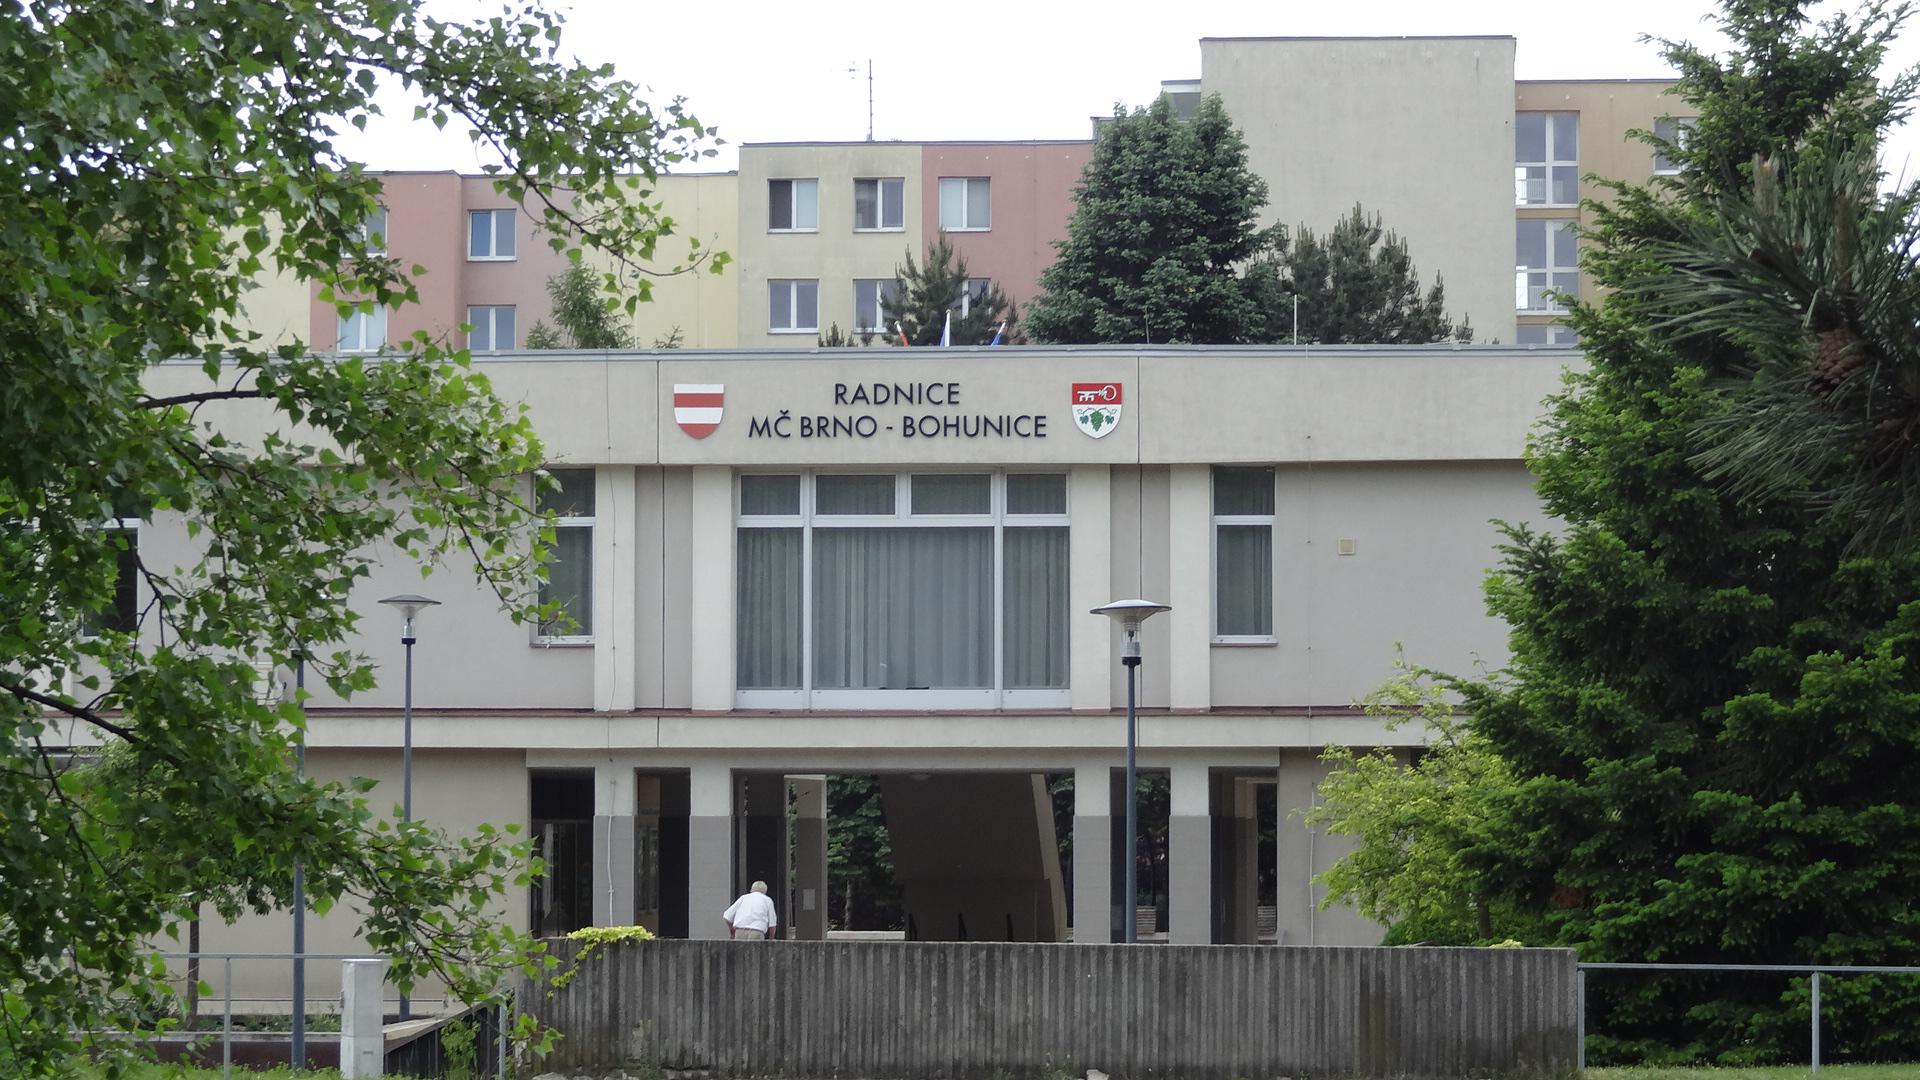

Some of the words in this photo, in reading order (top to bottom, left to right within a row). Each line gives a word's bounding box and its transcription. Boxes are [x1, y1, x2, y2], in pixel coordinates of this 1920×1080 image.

[834, 382, 960, 406] RADNICE
[748, 410, 792, 439] MČ
[800, 415, 878, 439] BRNO
[902, 414, 1047, 439] BOHUNICE
